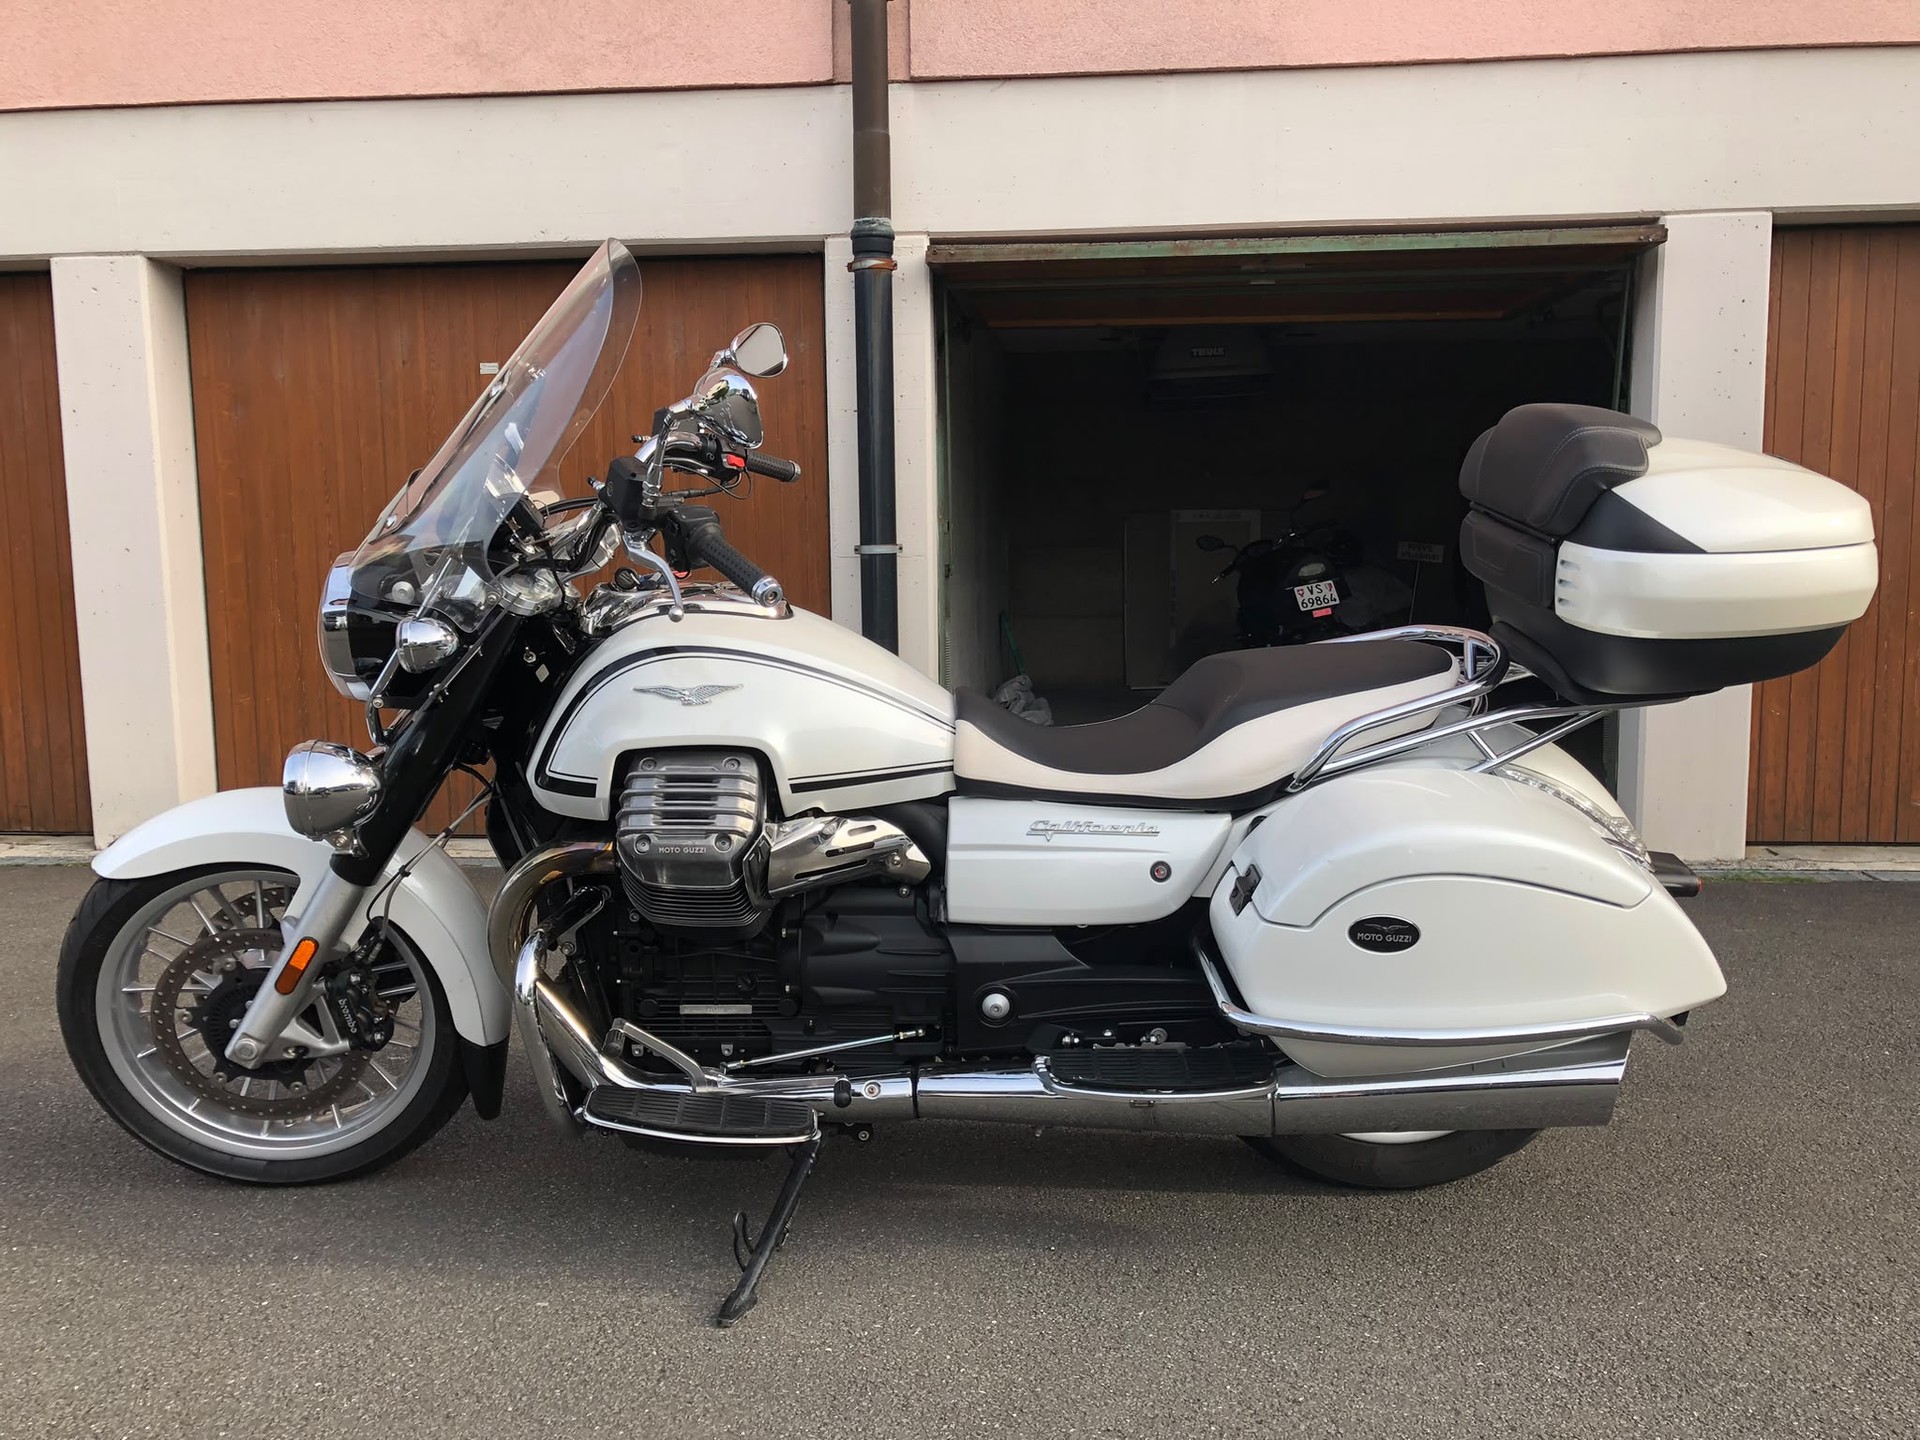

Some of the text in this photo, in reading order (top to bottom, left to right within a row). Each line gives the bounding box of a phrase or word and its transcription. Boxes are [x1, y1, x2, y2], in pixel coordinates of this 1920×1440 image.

[1306, 583, 1324, 596] VS
[1300, 593, 1337, 609] 69864
[1028, 820, 1160, 838] California
[658, 846, 707, 854] MOTO GUZZI
[1356, 932, 1412, 943] MOTO GUZZI
[338, 998, 358, 1034] brembo
